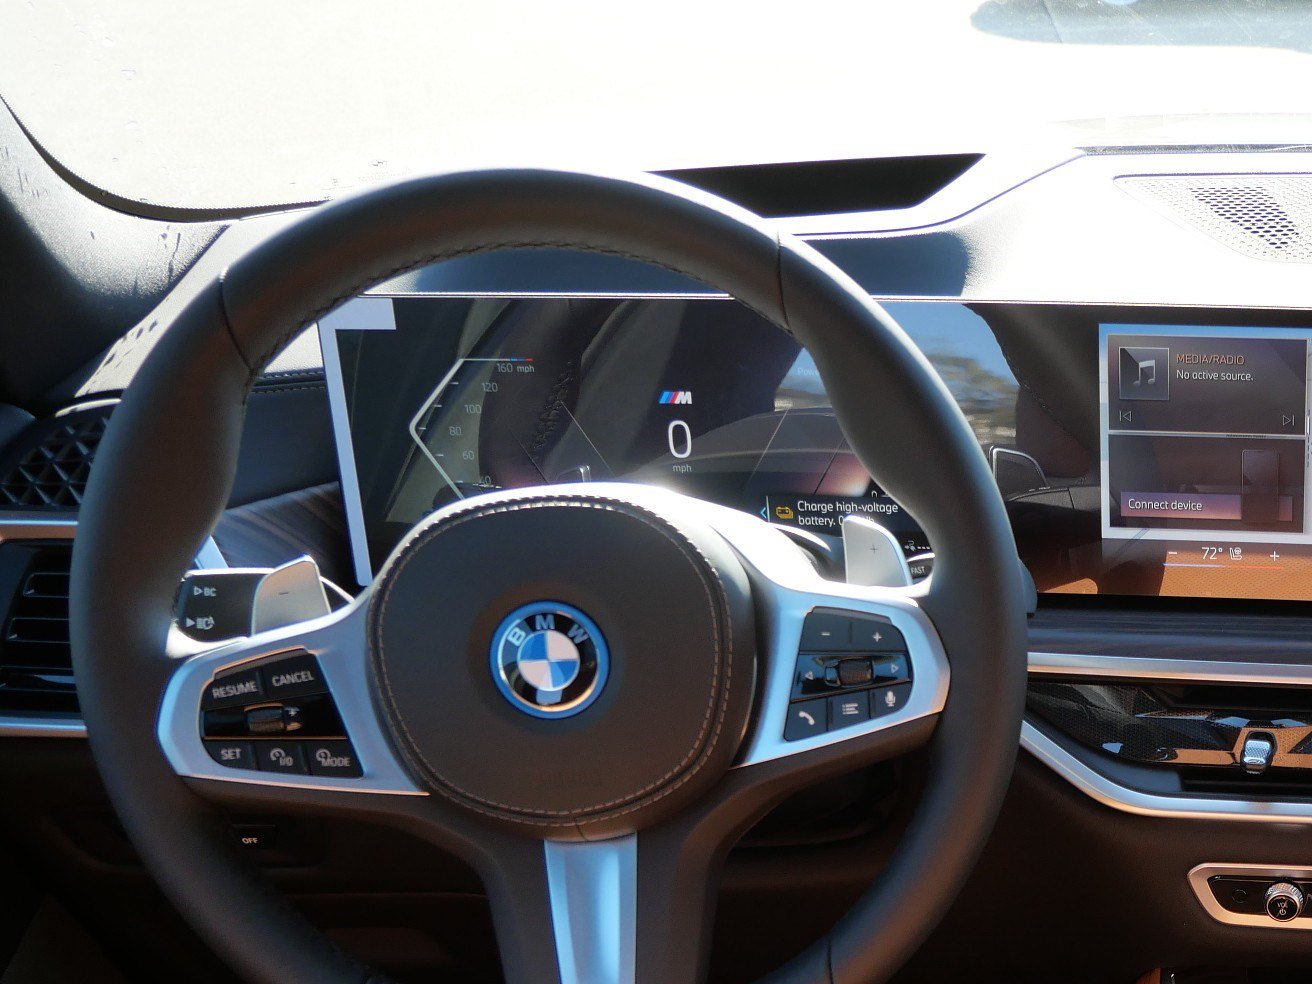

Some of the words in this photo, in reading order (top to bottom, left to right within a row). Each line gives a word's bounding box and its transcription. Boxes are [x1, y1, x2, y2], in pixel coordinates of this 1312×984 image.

[1176, 354, 1245, 365] MEDIA/RADIO
[496, 363, 513, 373] 160
[516, 364, 535, 373] mph
[1176, 369, 1190, 380] No
[1192, 370, 1219, 381] active
[1221, 372, 1254, 381] source.
[481, 382, 498, 393] 120
[464, 404, 481, 414] 100
[449, 426, 462, 436] 80
[668, 420, 692, 459] 0
[462, 450, 475, 460] 60
[672, 463, 692, 474] mph
[797, 500, 834, 514] Charge
[836, 501, 899, 515] high-voltage
[1128, 498, 1169, 510] Connect
[1171, 500, 1203, 511] device
[798, 515, 836, 528] battery.
[506, 613, 590, 647] BMW
[271, 670, 315, 687] CANCEL
[212, 681, 258, 699] RESUME
[220, 748, 242, 760] SET
[321, 757, 351, 767] MODE
